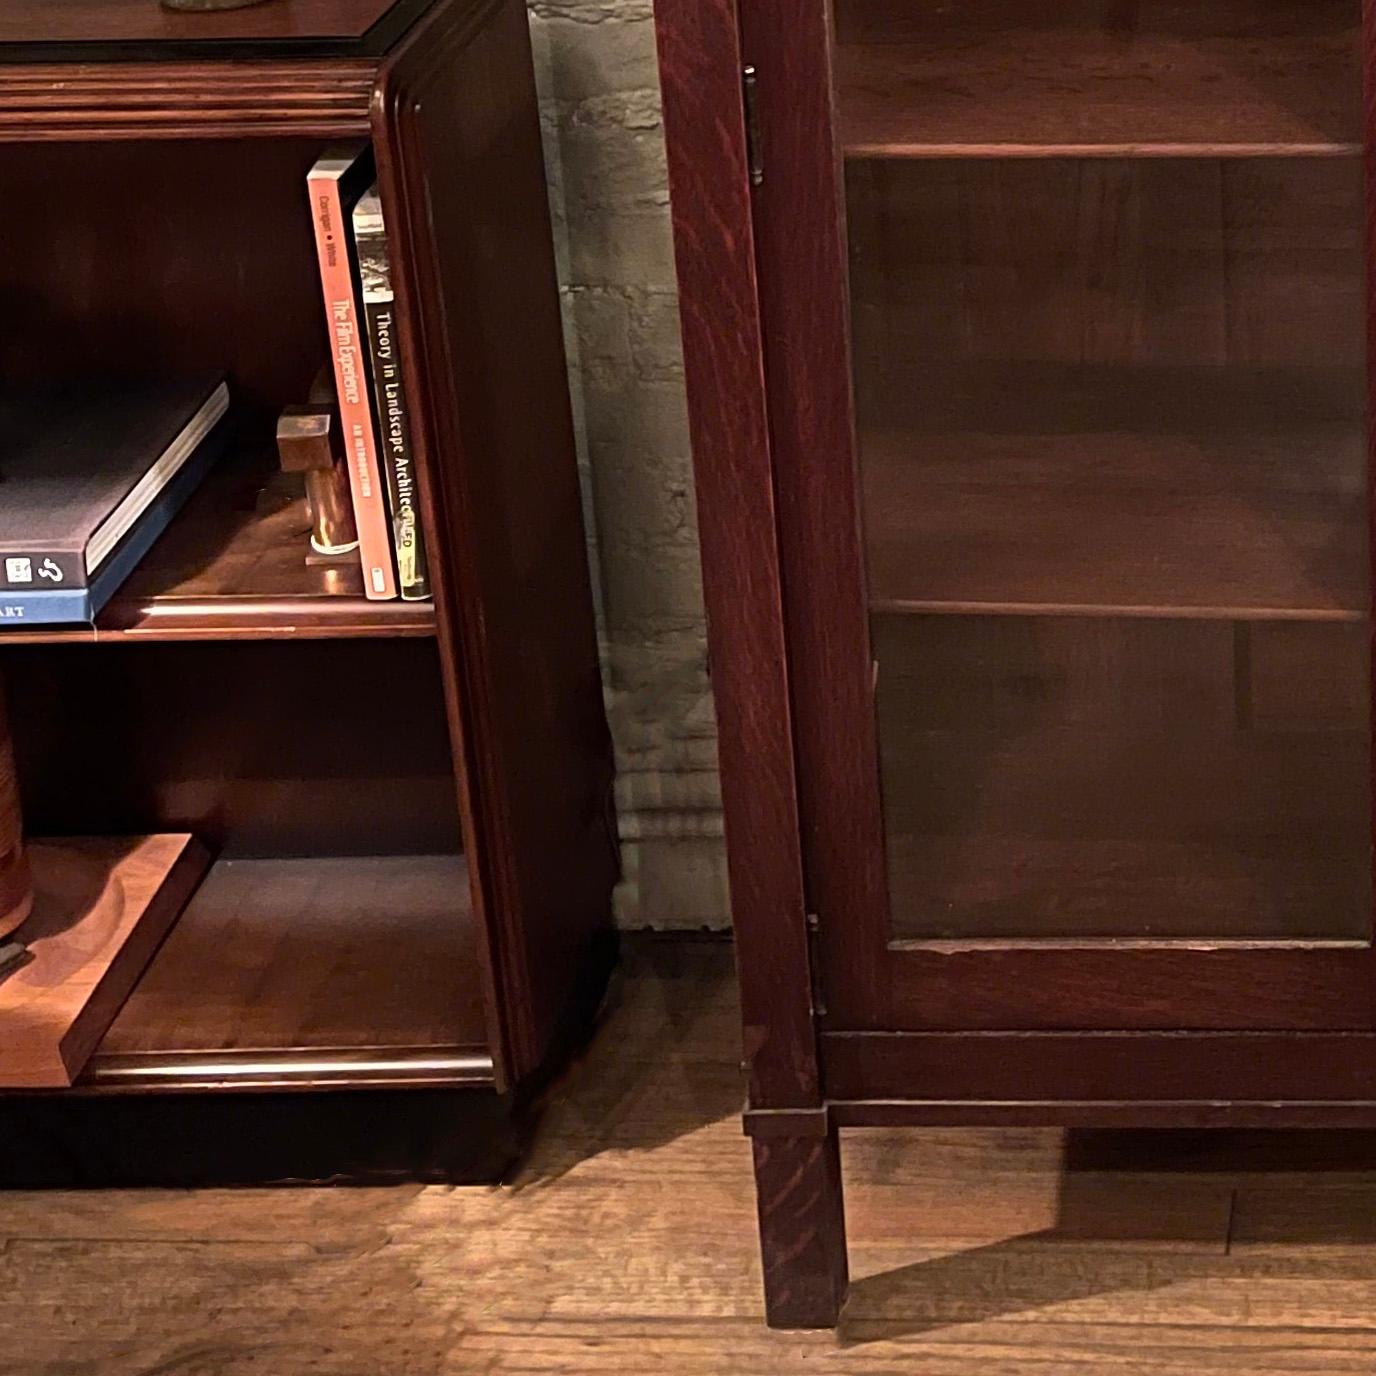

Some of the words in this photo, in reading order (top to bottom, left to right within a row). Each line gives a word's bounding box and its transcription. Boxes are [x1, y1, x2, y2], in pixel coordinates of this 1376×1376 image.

[319, 195, 332, 232] Corrigan
[325, 242, 336, 267] White
[332, 299, 350, 321] The
[335, 321, 354, 344] Film
[376, 311, 392, 359] Theory
[337, 345, 360, 405] Experience
[383, 363, 397, 378] in
[385, 382, 404, 453] Landscape
[394, 456, 413, 515] Architec
